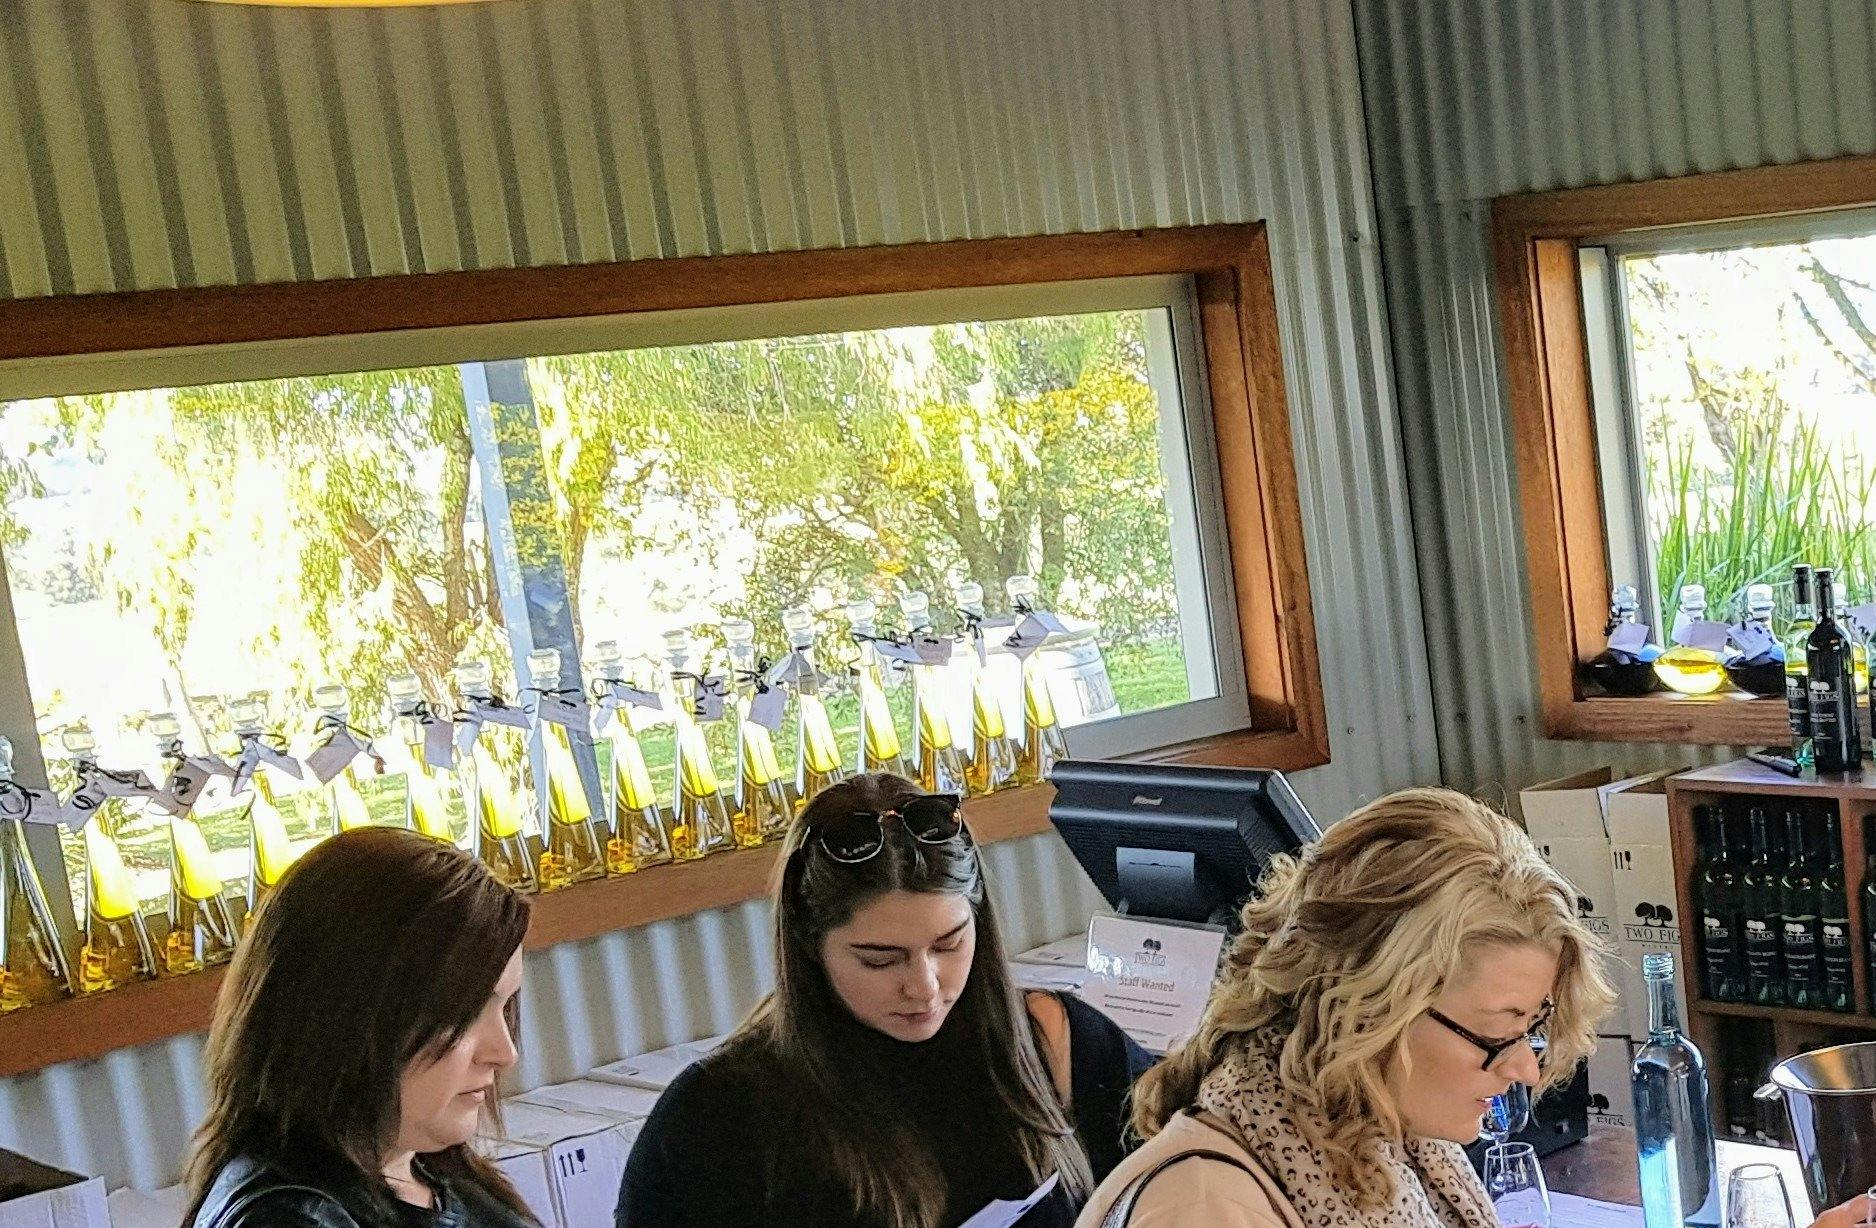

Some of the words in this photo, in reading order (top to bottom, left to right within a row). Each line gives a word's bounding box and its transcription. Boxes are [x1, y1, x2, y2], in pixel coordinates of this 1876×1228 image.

[1624, 926, 1653, 941] TWO
[1119, 974, 1140, 987] Staff
[1141, 978, 1176, 993] Wanted
